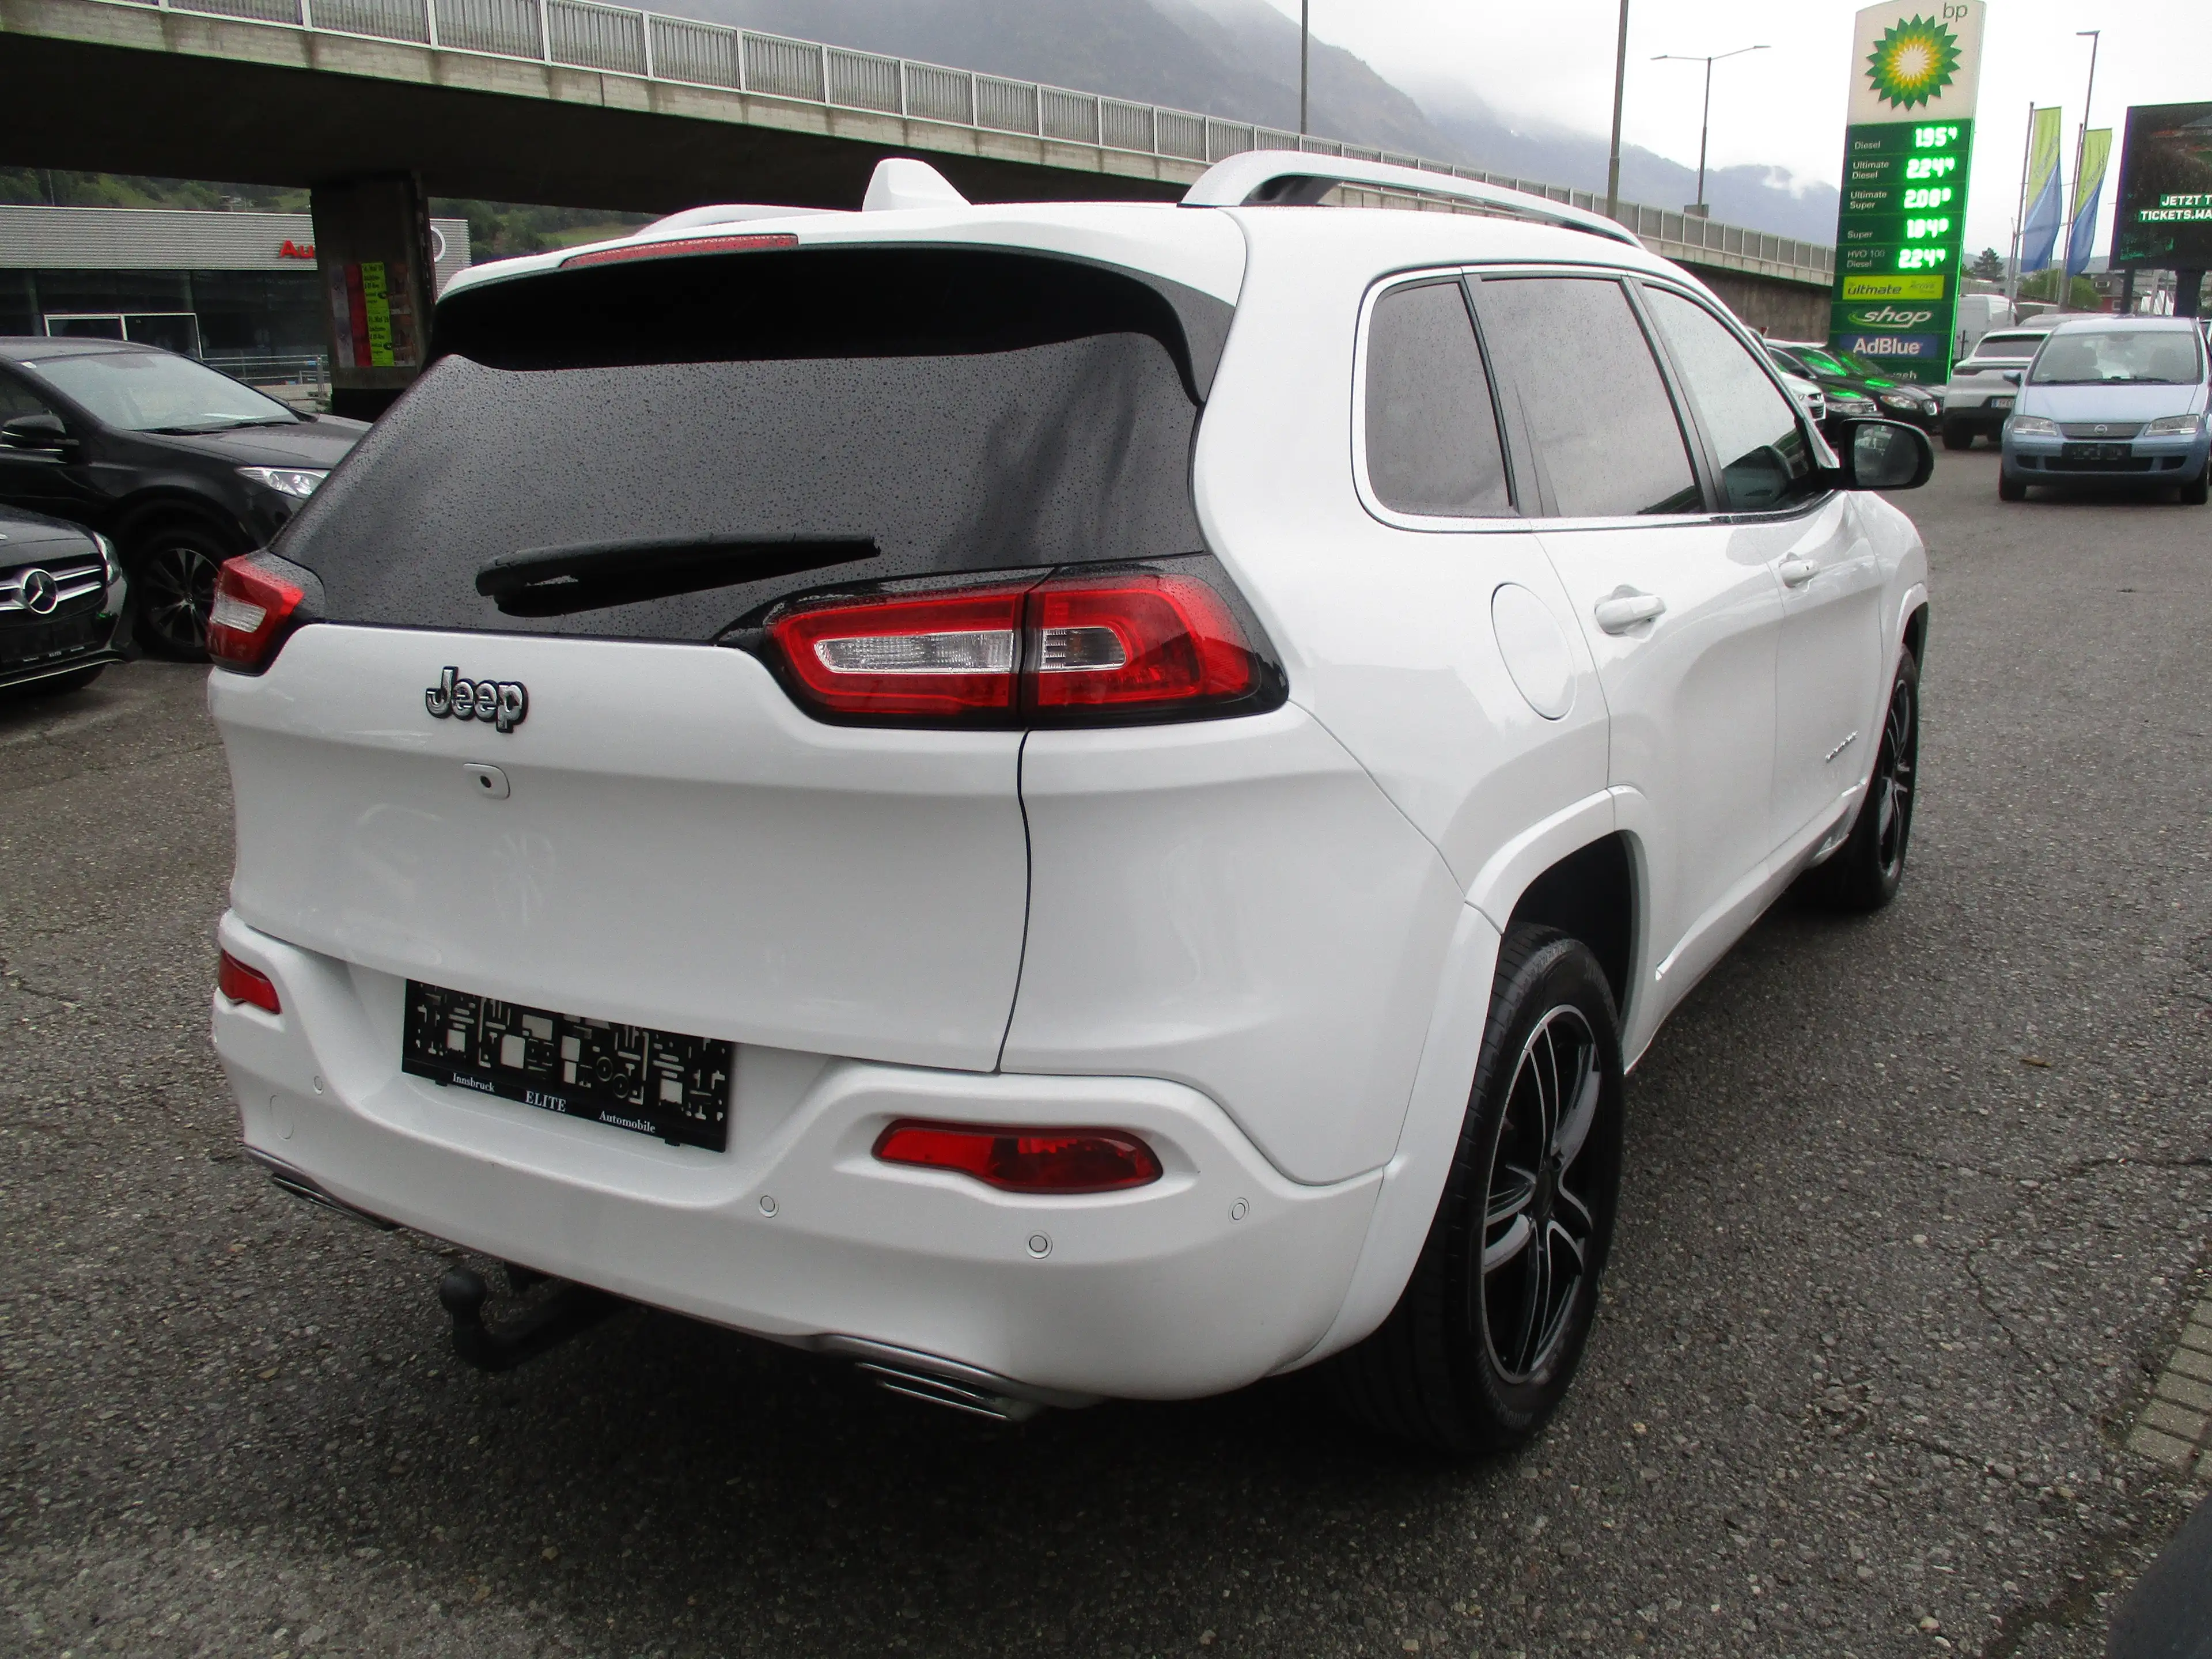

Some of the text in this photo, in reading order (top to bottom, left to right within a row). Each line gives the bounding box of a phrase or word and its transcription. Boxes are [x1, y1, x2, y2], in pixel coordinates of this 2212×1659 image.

[1943, 2, 1967, 22] bp
[1854, 141, 1881, 150] Diesel
[1853, 161, 1889, 169] Ultimate
[1852, 171, 1878, 180] Diesel
[1850, 191, 1888, 199] Ultimate
[2161, 195, 2212, 206] JETZT T
[1850, 202, 1875, 210] Super
[2141, 209, 2212, 221] TICKETS.WA
[1847, 230, 1873, 239] Super
[279, 240, 315, 259] Au
[1847, 249, 1885, 259] HVO 100
[1846, 260, 1872, 268] Diesel
[1847, 284, 1902, 294] ultimate
[1865, 306, 1932, 328] shop
[1853, 338, 1921, 355] AdBlue
[426, 666, 528, 733] Jeep
[453, 1072, 656, 1134] Innsbruck ELITE Automobile
